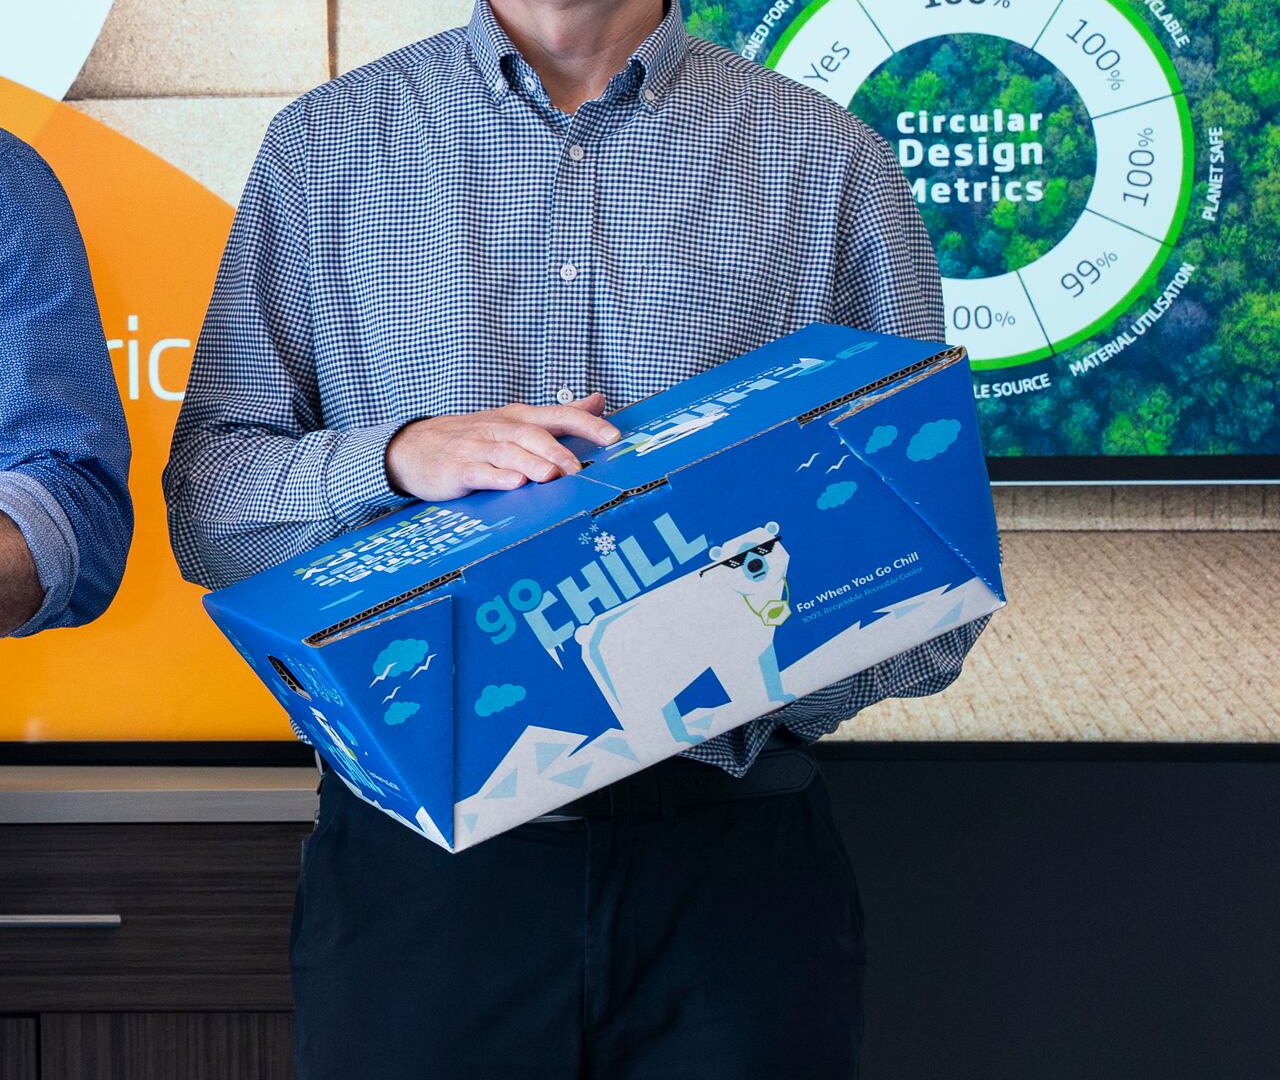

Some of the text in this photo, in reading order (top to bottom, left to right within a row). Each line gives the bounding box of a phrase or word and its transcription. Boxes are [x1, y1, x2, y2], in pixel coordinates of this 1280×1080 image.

[762, 0, 790, 27] FOR
[804, 39, 851, 86] Yes
[1066, 18, 1125, 91] 100%
[896, 109, 1043, 134] Circular
[898, 137, 1043, 173] Design
[1123, 127, 1156, 208] 100%
[1202, 126, 1225, 222] PLANET SAFE
[910, 175, 1044, 203] Metrics
[1060, 251, 1118, 299] 99%
[945, 305, 1016, 330] 00%
[1069, 261, 1196, 377] MATERIAL UTILISATION
[992, 373, 1052, 398] SOURCE
[523, 512, 708, 653] CHILL
[796, 551, 920, 613] For When You Go Chill
[476, 578, 542, 645] go
